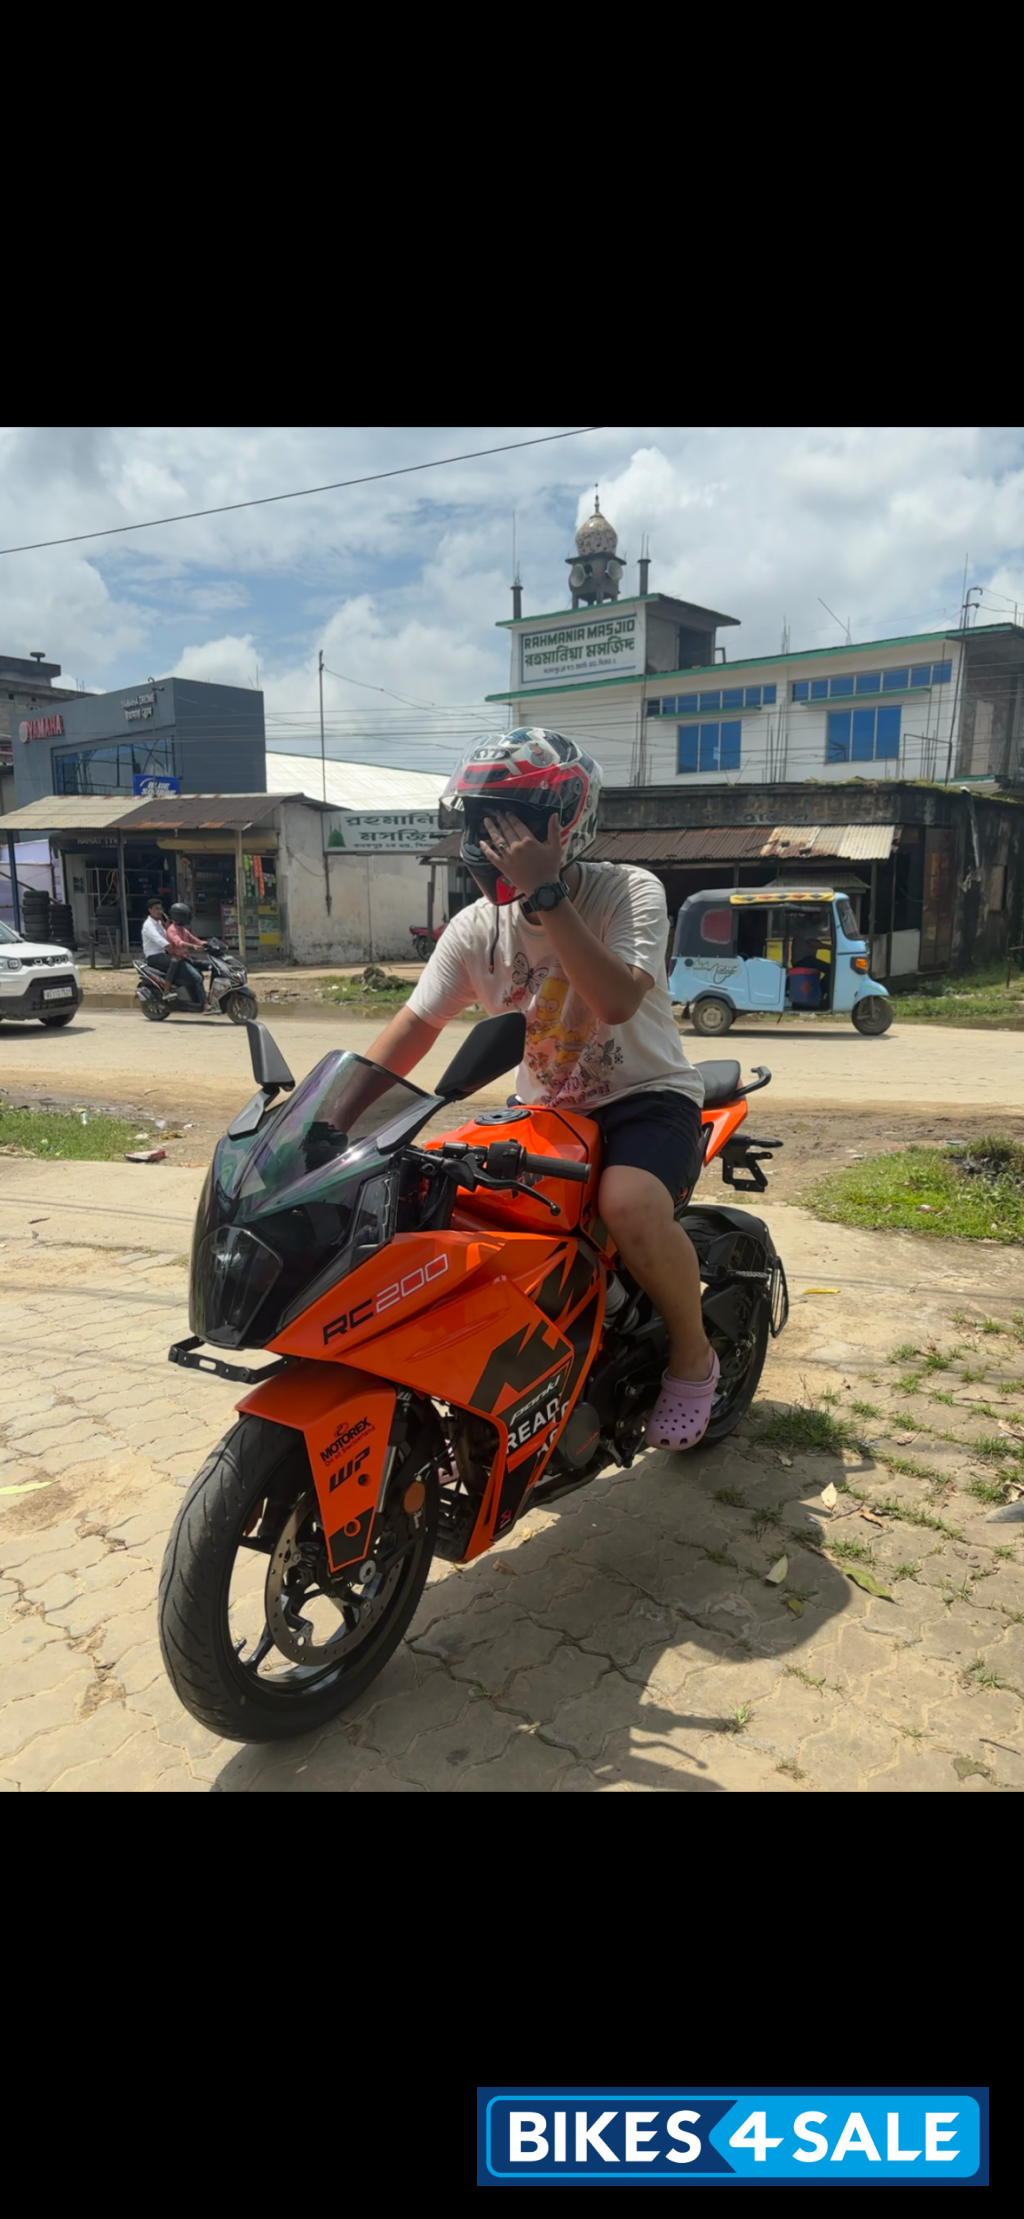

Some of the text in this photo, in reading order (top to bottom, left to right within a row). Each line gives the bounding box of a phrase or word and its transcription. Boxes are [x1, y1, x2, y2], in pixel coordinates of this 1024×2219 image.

[524, 619, 636, 650] RAHMANIA MASJID
[585, 635, 636, 658] মসজিদ
[27, 715, 63, 741] YAMAHA
[319, 1416, 372, 1462] MOTOREX
